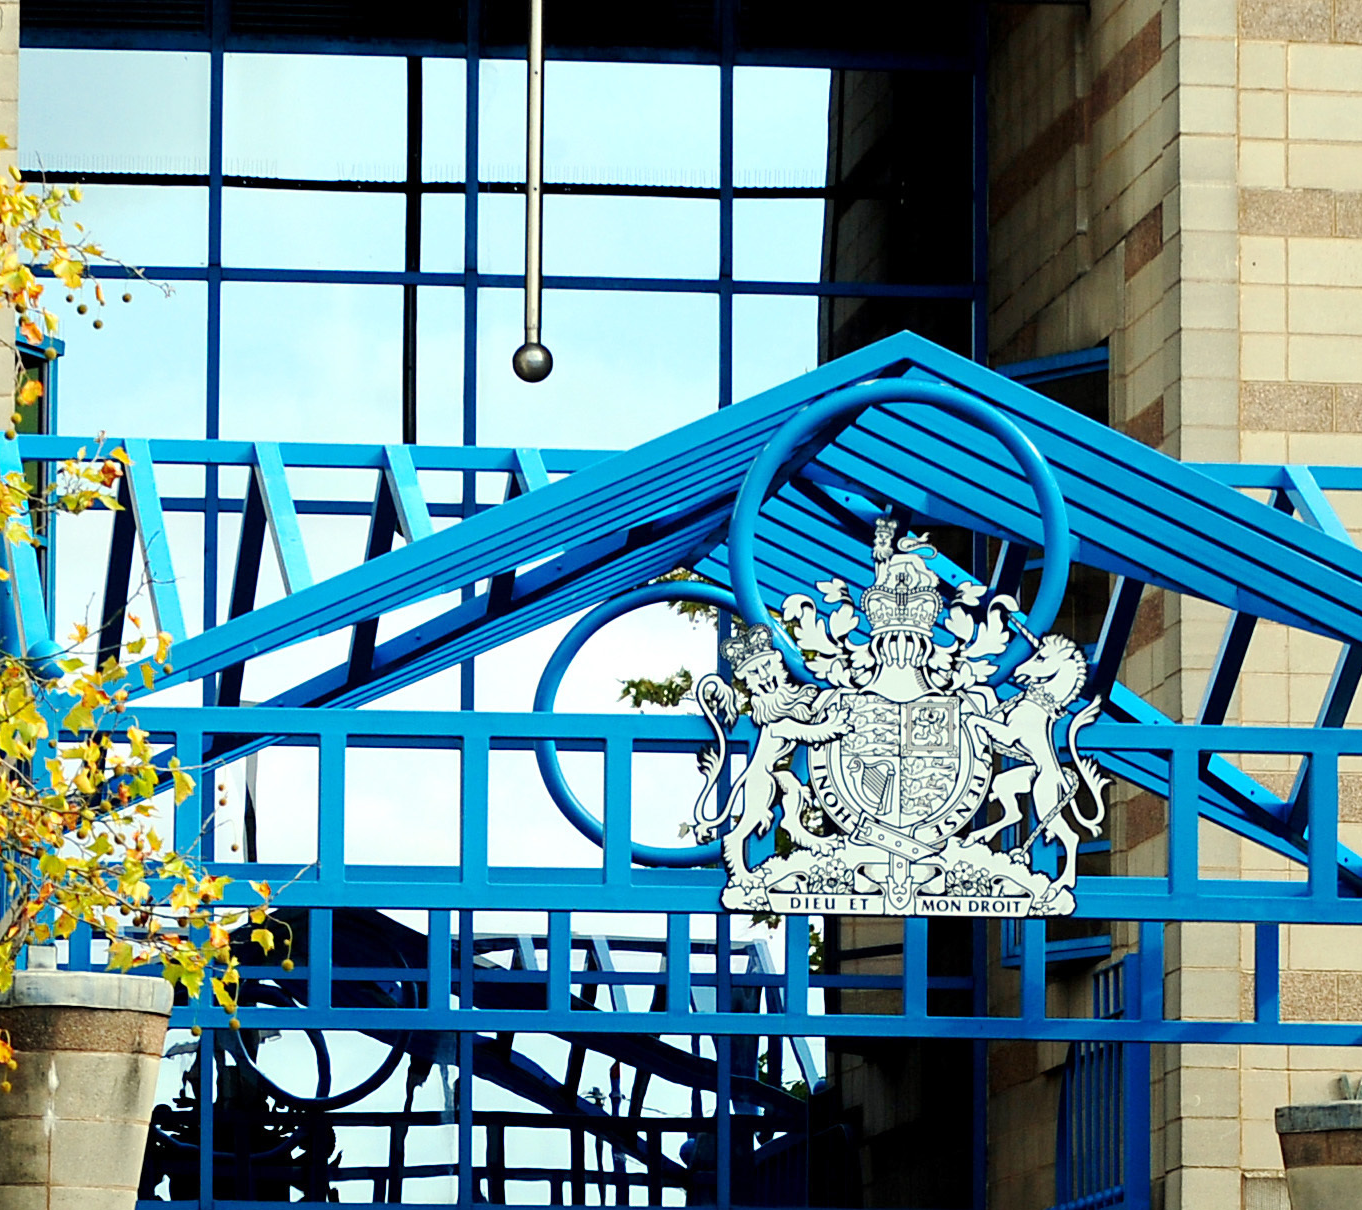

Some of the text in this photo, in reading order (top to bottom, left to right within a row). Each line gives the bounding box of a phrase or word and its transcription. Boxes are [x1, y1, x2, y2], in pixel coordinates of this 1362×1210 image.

[813, 765, 986, 837] HONI PENSE
[790, 897, 1021, 913] DIEU ET MON DROIT
